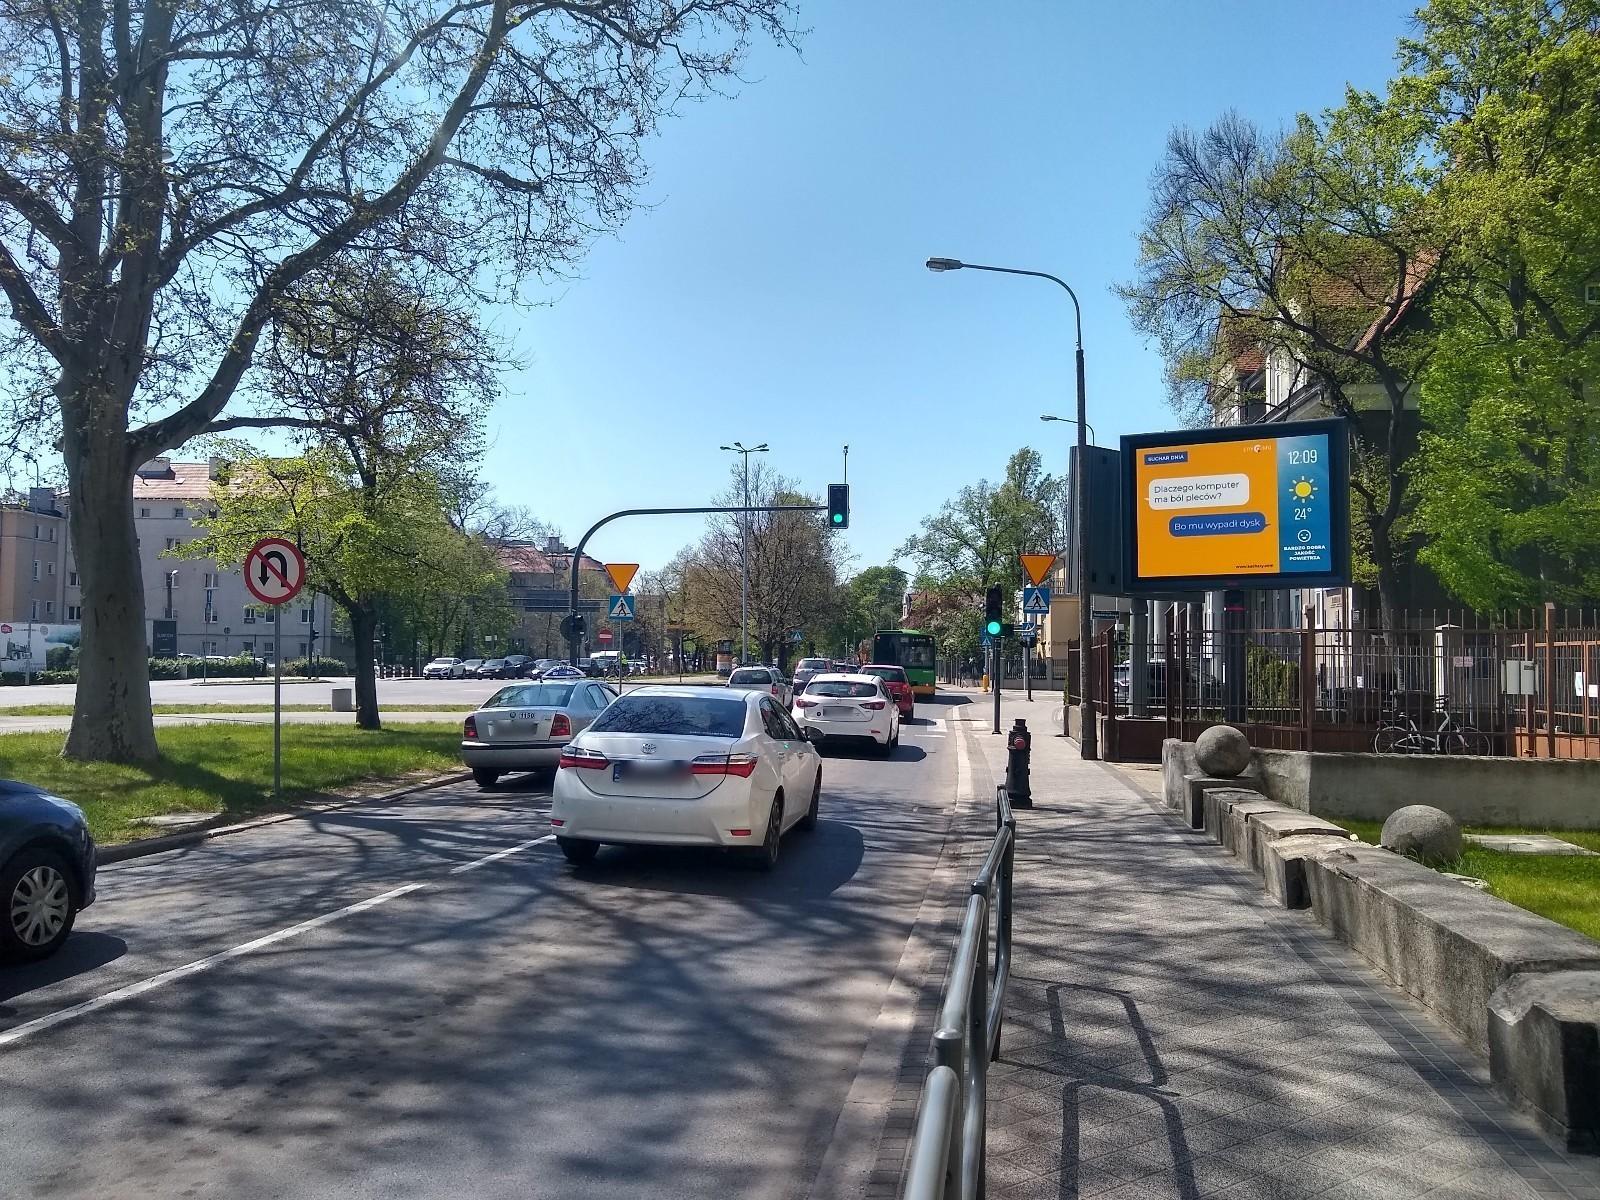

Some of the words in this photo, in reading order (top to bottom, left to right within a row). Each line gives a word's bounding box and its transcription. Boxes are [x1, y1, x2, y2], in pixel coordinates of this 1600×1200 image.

[1288, 449, 1317, 465] 12:09
[1154, 484, 1194, 494] Dlaczego
[1195, 481, 1240, 491] komputer
[1170, 493, 1184, 503] ból
[1186, 492, 1222, 503] pleców?
[1174, 523, 1186, 531] Bo
[1188, 522, 1204, 530] mu
[1240, 518, 1261, 528] dysk
